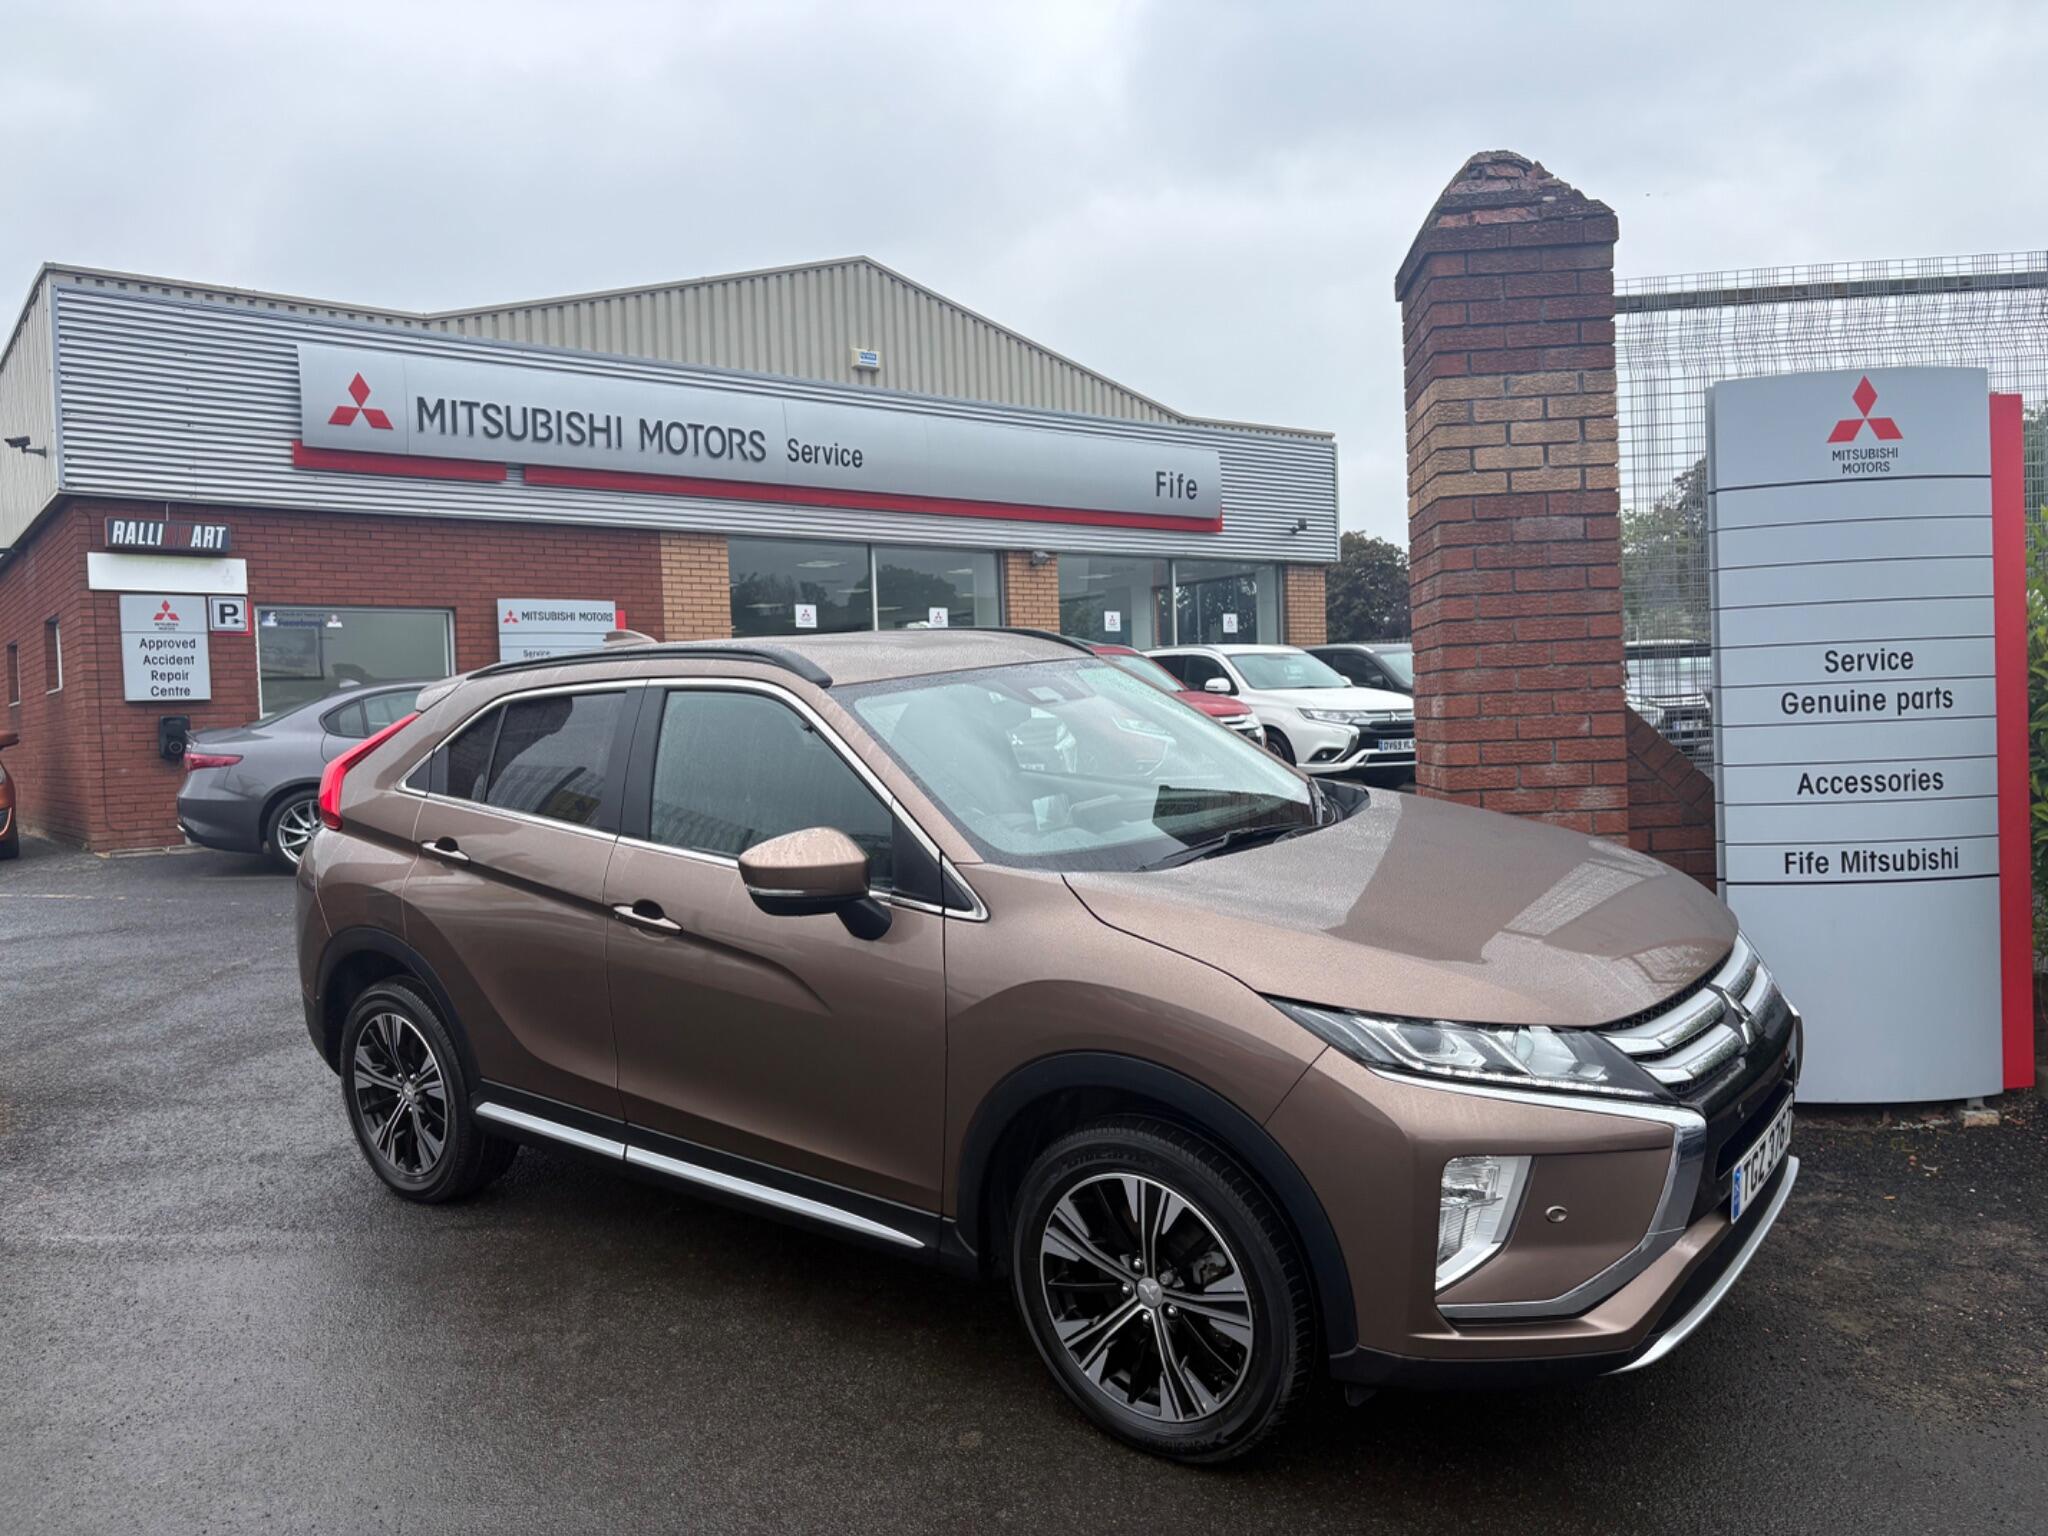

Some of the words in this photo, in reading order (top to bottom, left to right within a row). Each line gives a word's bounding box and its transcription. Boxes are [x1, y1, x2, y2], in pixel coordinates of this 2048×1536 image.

[416, 396, 622, 449] MITSUBISHI
[639, 418, 767, 462] MOTORS
[787, 437, 863, 468] Service
[1832, 447, 1898, 461] MITSUBISHI
[1842, 461, 1890, 474] MOTORS
[1155, 470, 1198, 500] Fife
[218, 604, 239, 624] P
[521, 610, 576, 621] MITSUBISHI
[579, 611, 613, 622] MOTORS
[139, 638, 196, 651] Approved
[143, 654, 195, 665] Accident
[1824, 648, 1914, 673] Service
[151, 670, 190, 683] Repair
[150, 686, 191, 697] Centre
[1781, 690, 1886, 715] Genuine
[1897, 687, 1954, 716] parts
[1797, 769, 1945, 795] Accessories
[1784, 851, 1829, 874] Fife
[1841, 846, 1960, 873] Mitsubishi
[1743, 1140, 1767, 1201] TGZ
